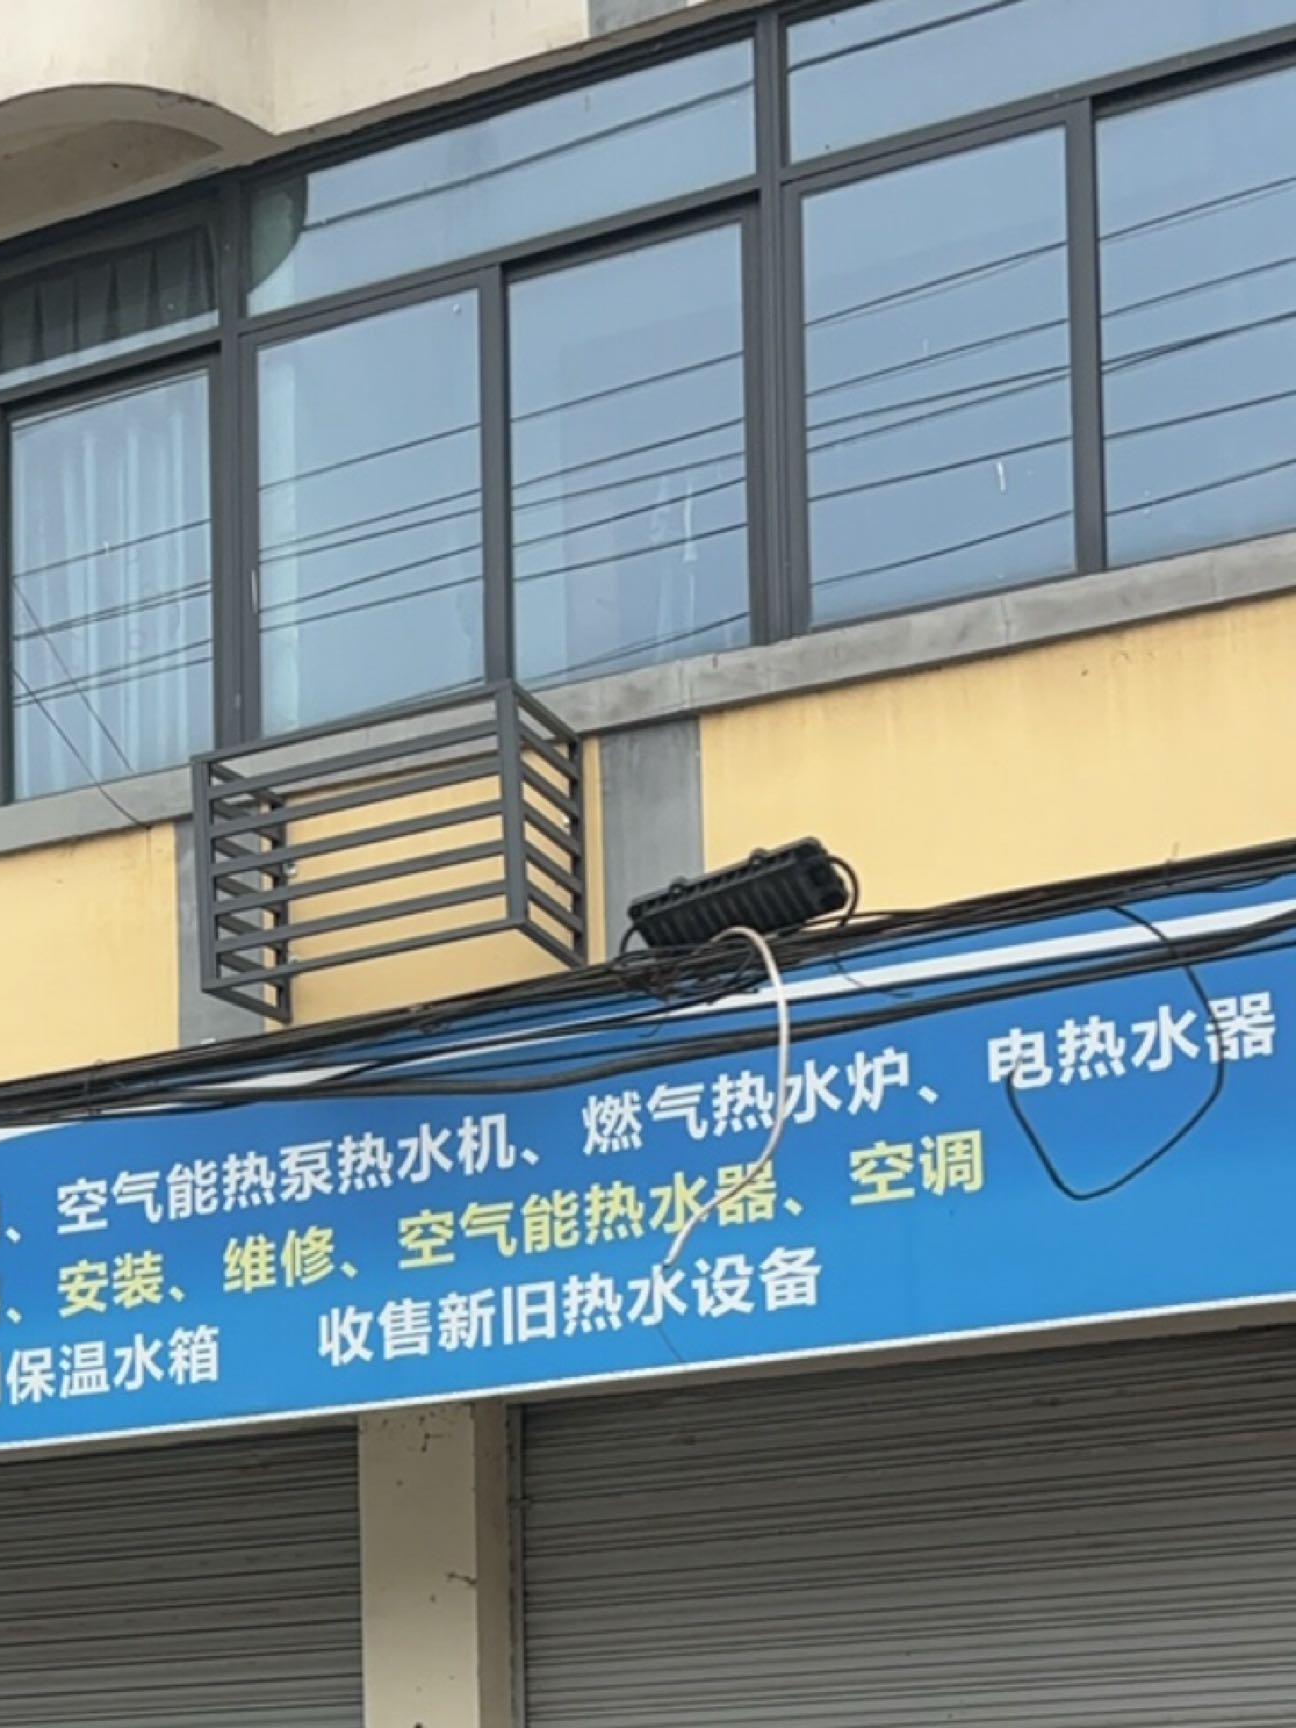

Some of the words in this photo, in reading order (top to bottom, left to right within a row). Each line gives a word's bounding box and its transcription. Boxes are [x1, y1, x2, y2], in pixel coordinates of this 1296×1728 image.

[317, 1246, 822, 1368] 收售新旧热水设备
